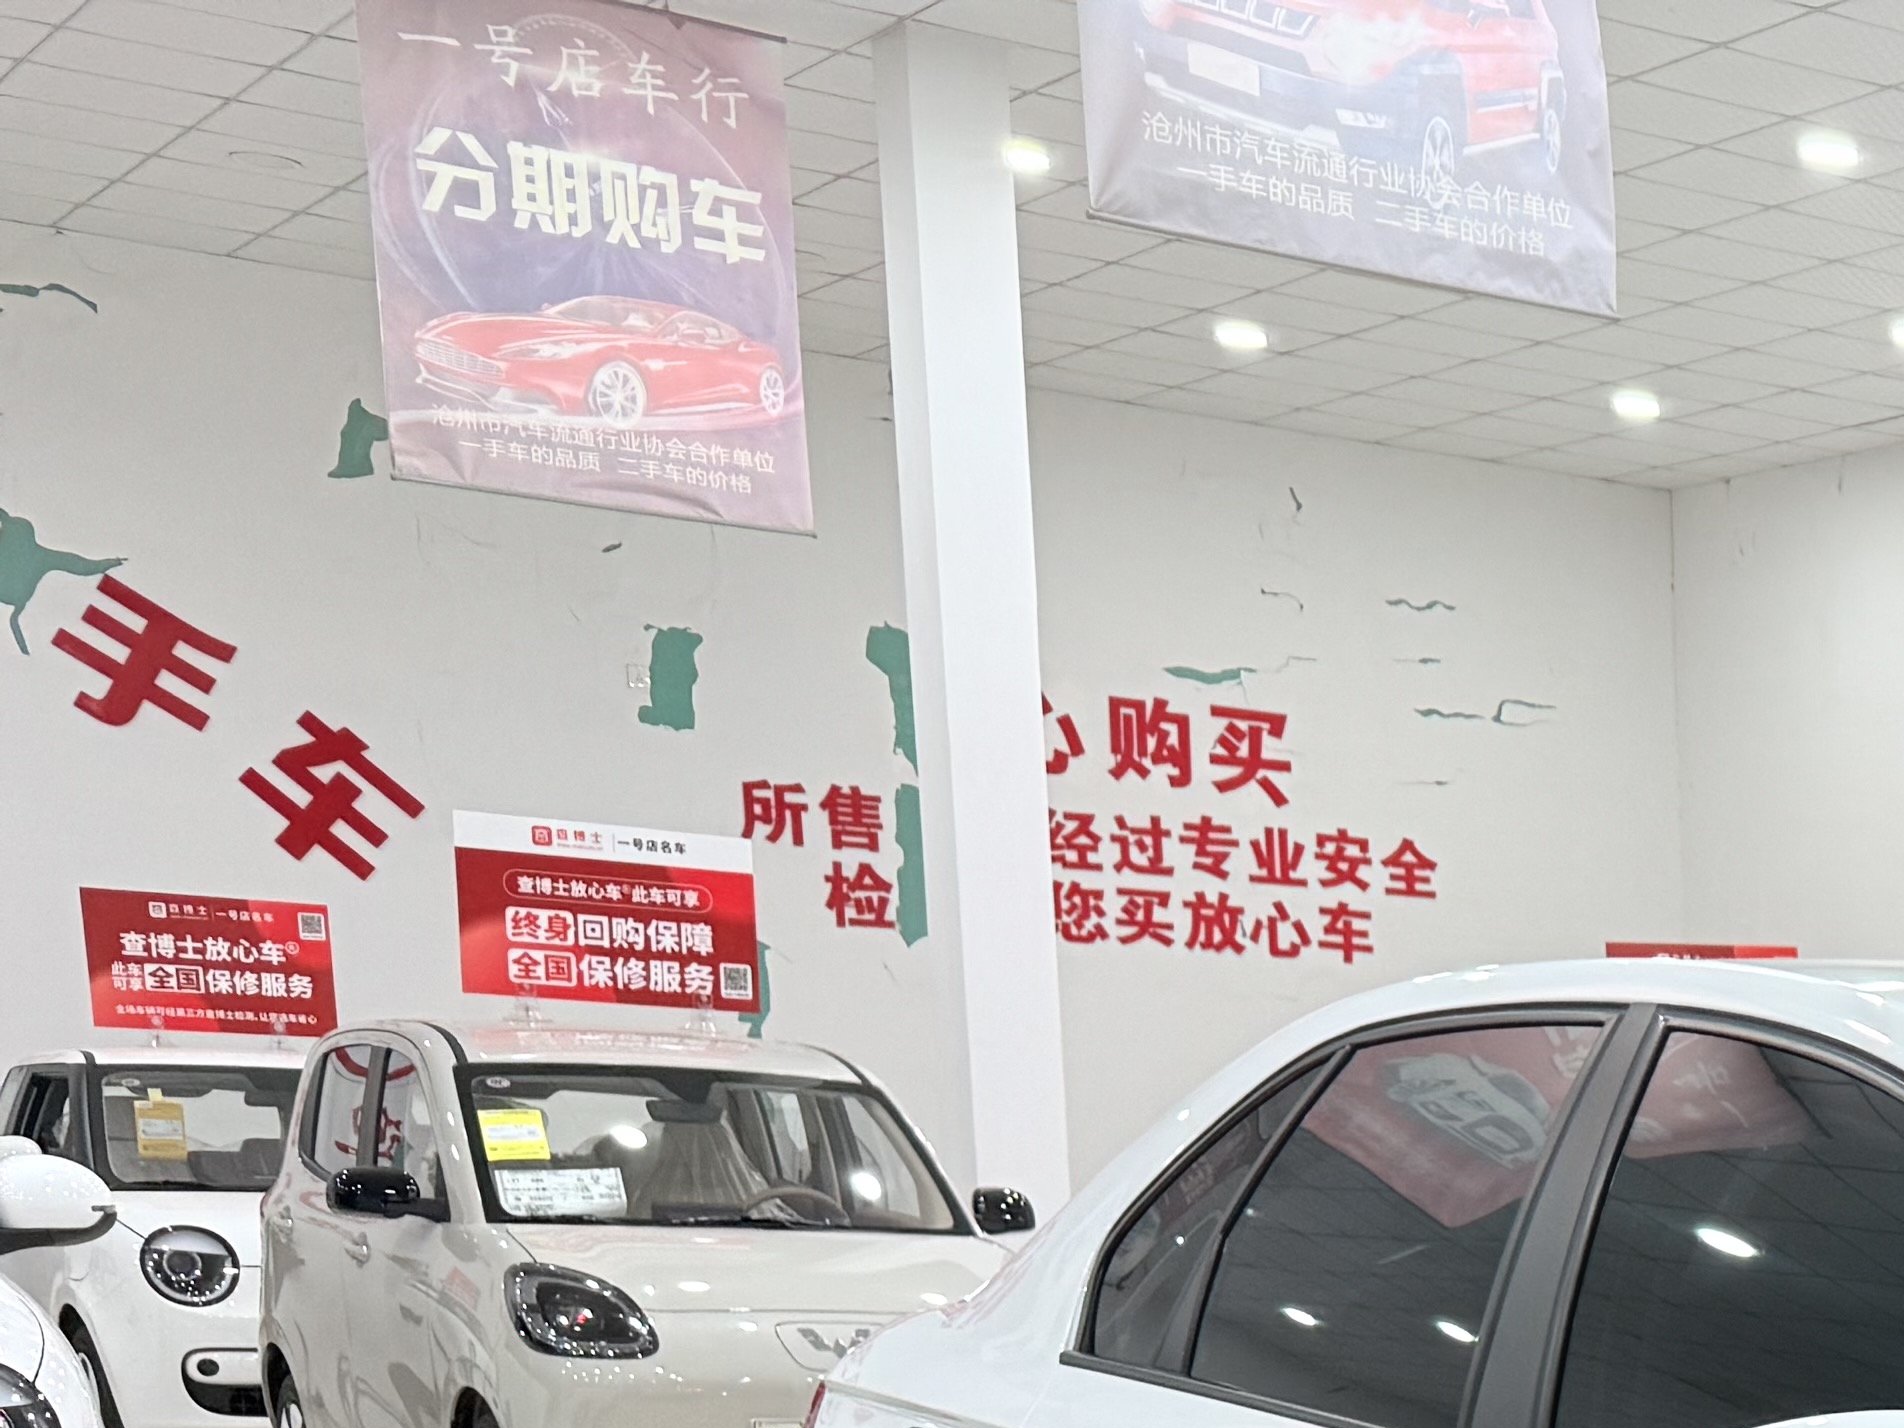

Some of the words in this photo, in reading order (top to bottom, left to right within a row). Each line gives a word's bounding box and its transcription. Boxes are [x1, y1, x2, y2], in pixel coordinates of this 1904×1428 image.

[397, 24, 749, 129] 一号店车行
[414, 126, 766, 264] 分期购车
[1142, 112, 1575, 230] 沧州市汽车流通行业协会合作单位
[1177, 163, 1355, 221] 一手车的品质
[1375, 199, 1546, 257] 二手车的价格
[458, 438, 601, 473] 一手车的品质
[617, 456, 753, 494] 二手车的价格
[510, 909, 714, 957] 终身回购保障
[147, 964, 314, 999] 全国保修服务
[511, 951, 715, 995] 全国保修服务
